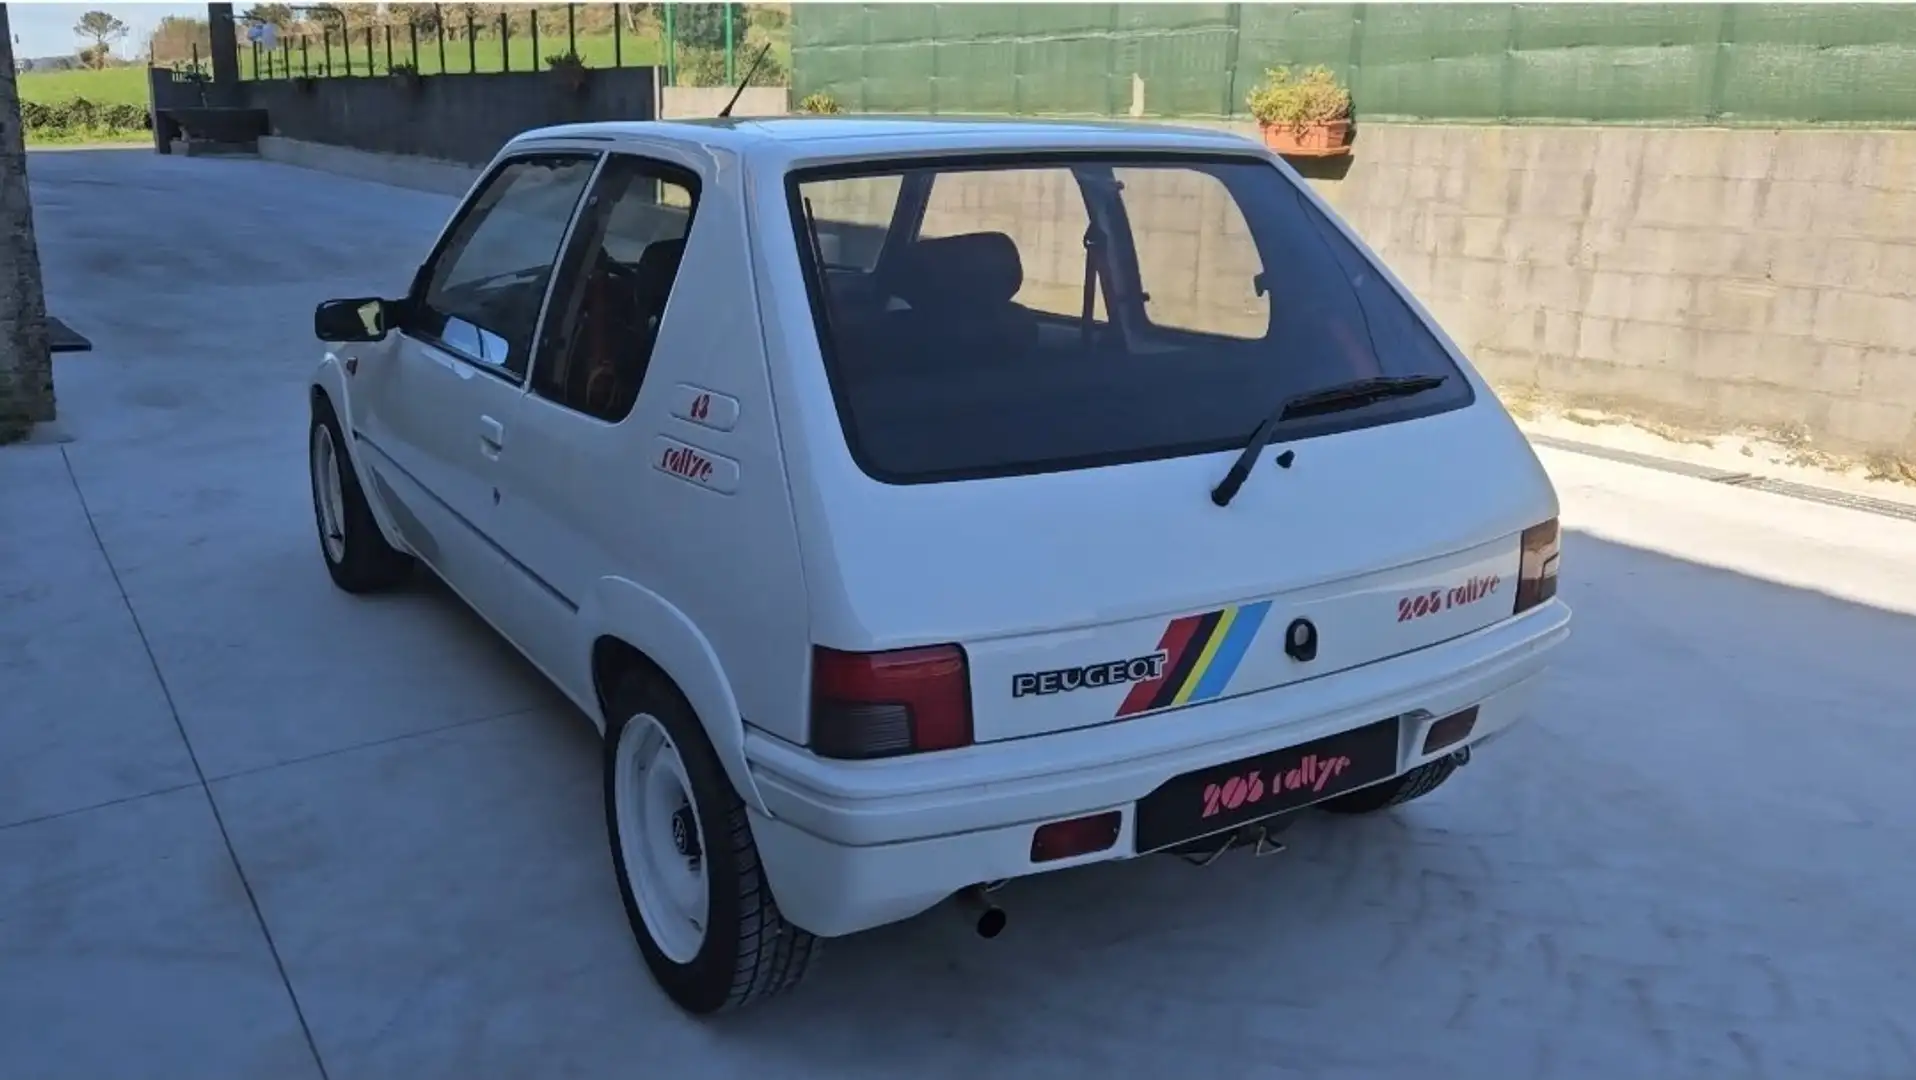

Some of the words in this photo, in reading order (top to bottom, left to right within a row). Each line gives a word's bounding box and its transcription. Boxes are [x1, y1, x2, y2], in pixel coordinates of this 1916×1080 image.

[661, 447, 713, 482] rallye
[1398, 589, 1440, 622] 205
[1447, 575, 1500, 609] rallye
[1012, 652, 1167, 698] PEUGEOT
[1202, 770, 1264, 818] 205
[1272, 754, 1350, 795] rallye
